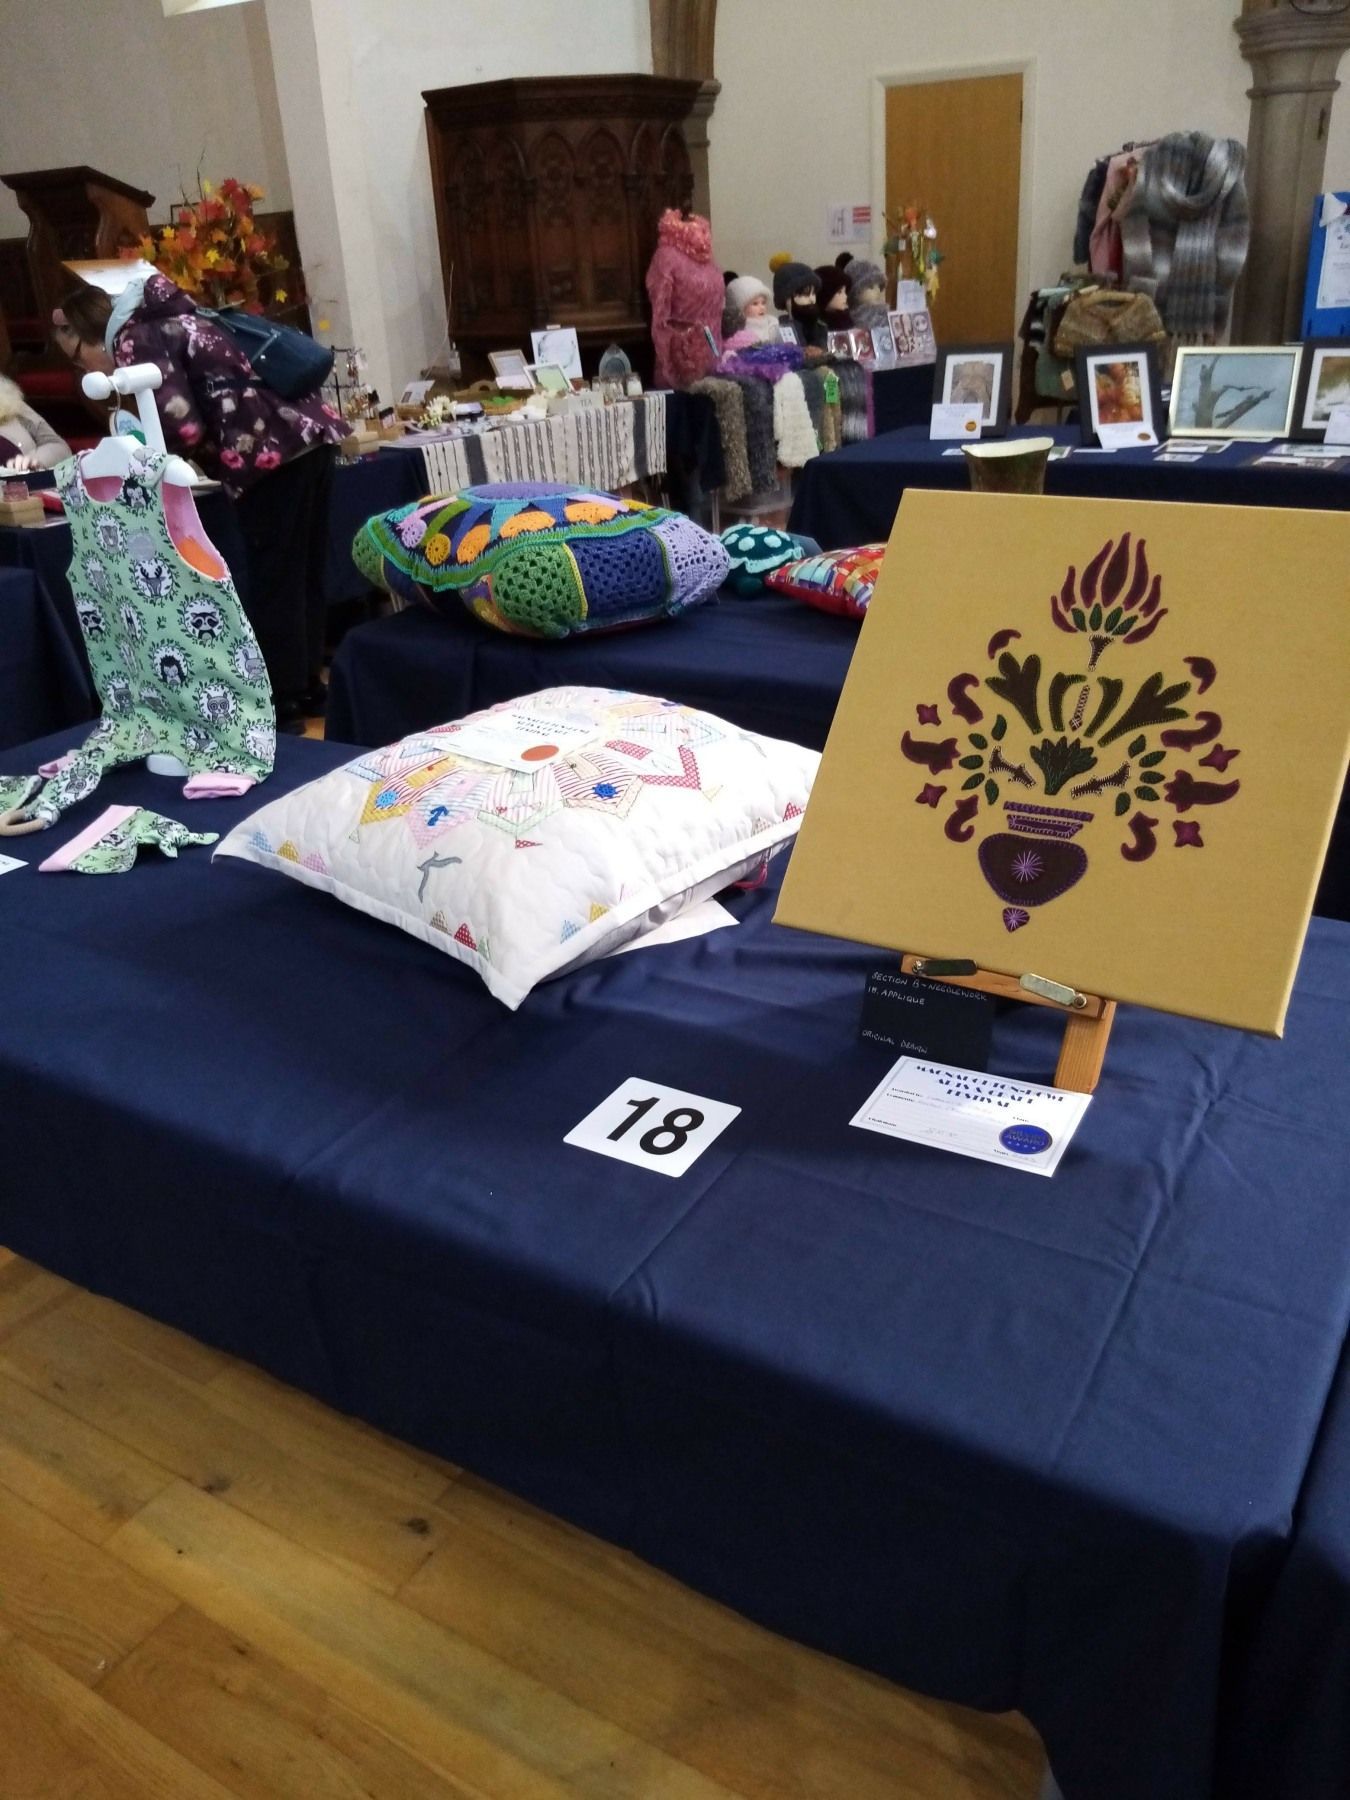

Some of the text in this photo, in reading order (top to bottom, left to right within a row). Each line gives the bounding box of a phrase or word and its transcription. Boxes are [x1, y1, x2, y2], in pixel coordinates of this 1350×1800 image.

[871, 971, 908, 985] SECTION
[880, 989, 926, 1005] APPLIQUE
[606, 1096, 705, 1156] 18
